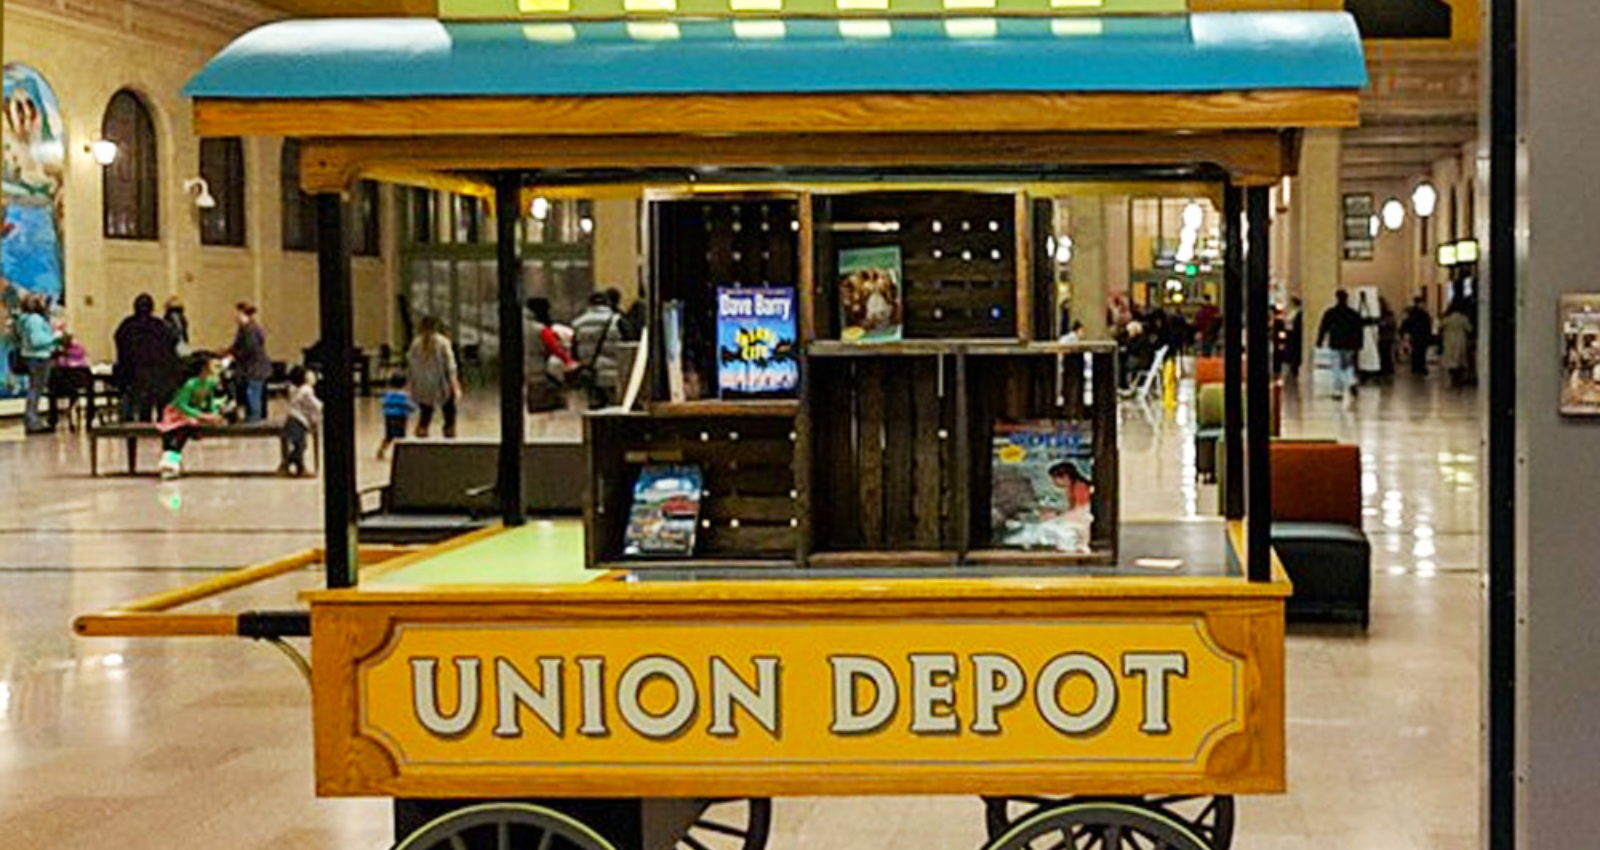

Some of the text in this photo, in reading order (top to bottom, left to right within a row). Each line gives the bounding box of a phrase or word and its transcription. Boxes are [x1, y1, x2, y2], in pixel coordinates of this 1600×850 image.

[720, 293, 791, 321] Dave Barry
[408, 651, 1187, 739] UNION DEPOT
